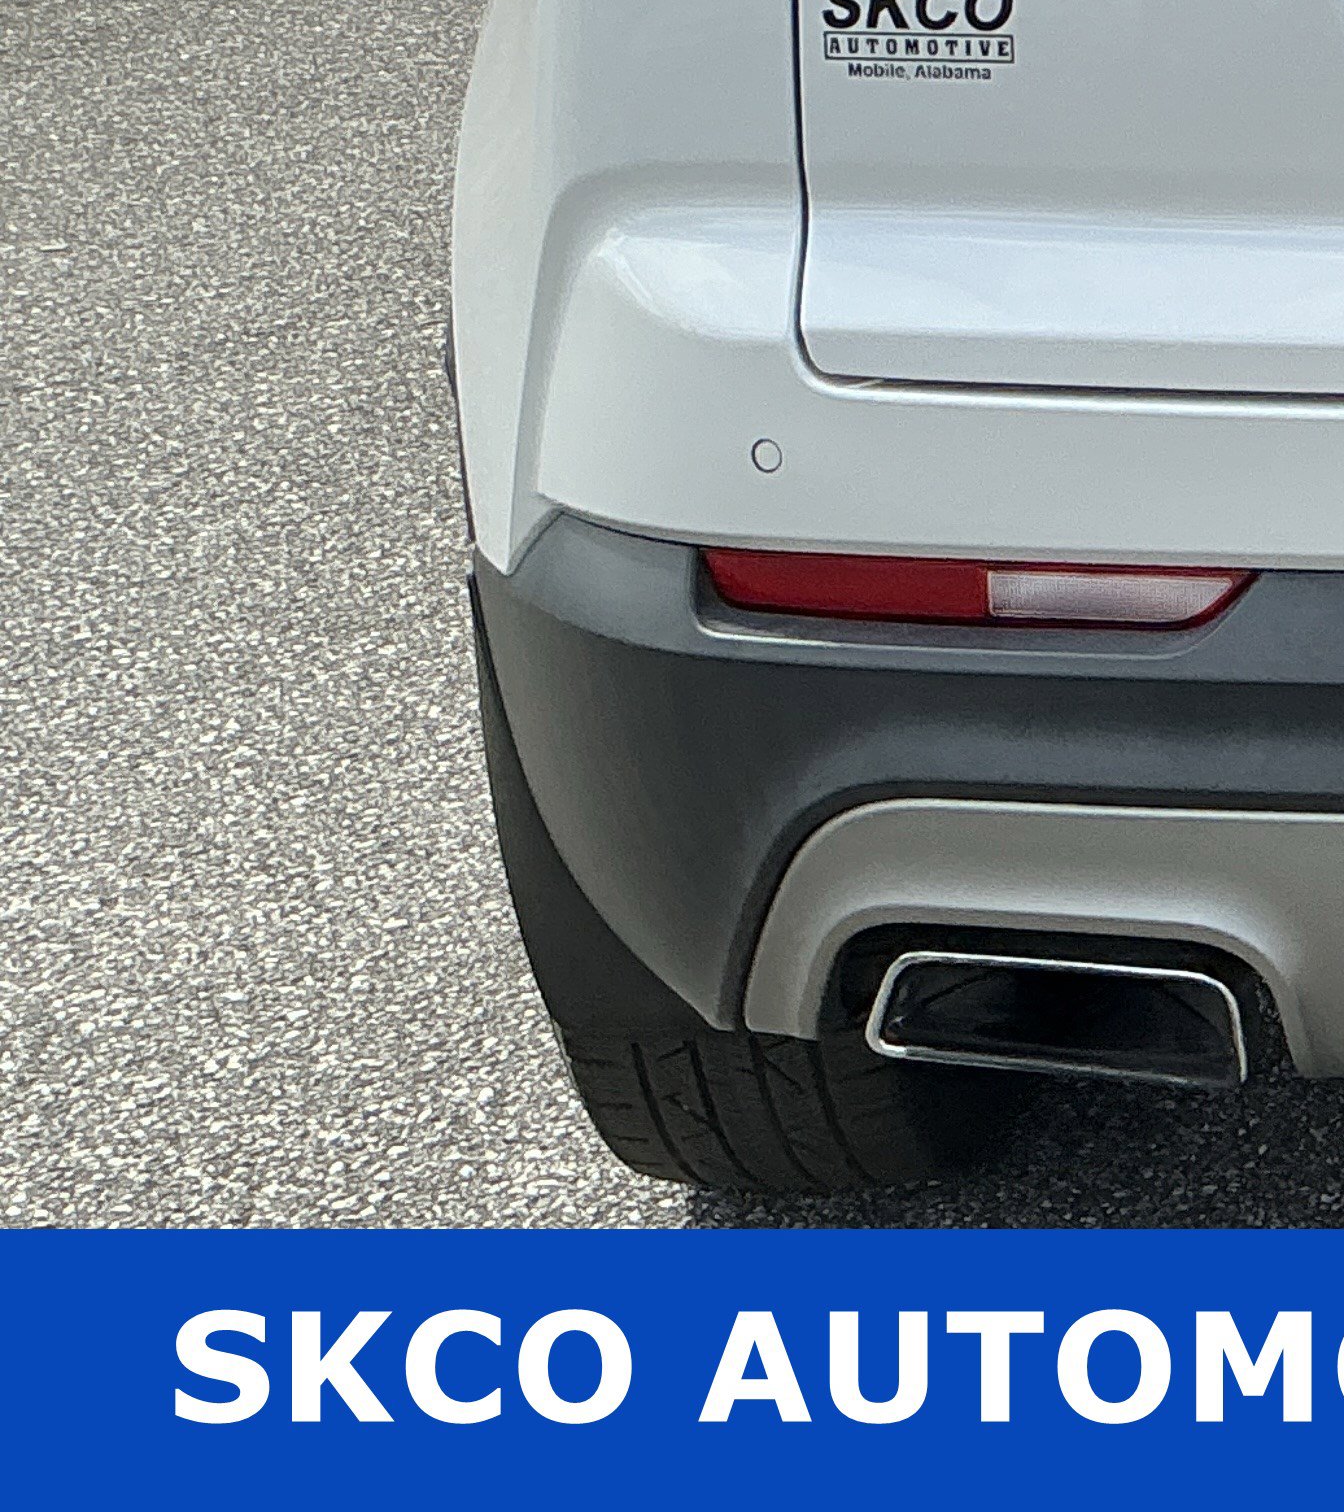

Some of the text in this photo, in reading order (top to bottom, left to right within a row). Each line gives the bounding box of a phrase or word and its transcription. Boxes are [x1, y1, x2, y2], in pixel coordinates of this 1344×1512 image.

[829, 37, 1010, 57] AUTOMOTIVE
[848, 63, 992, 80] Mobile, Alabama
